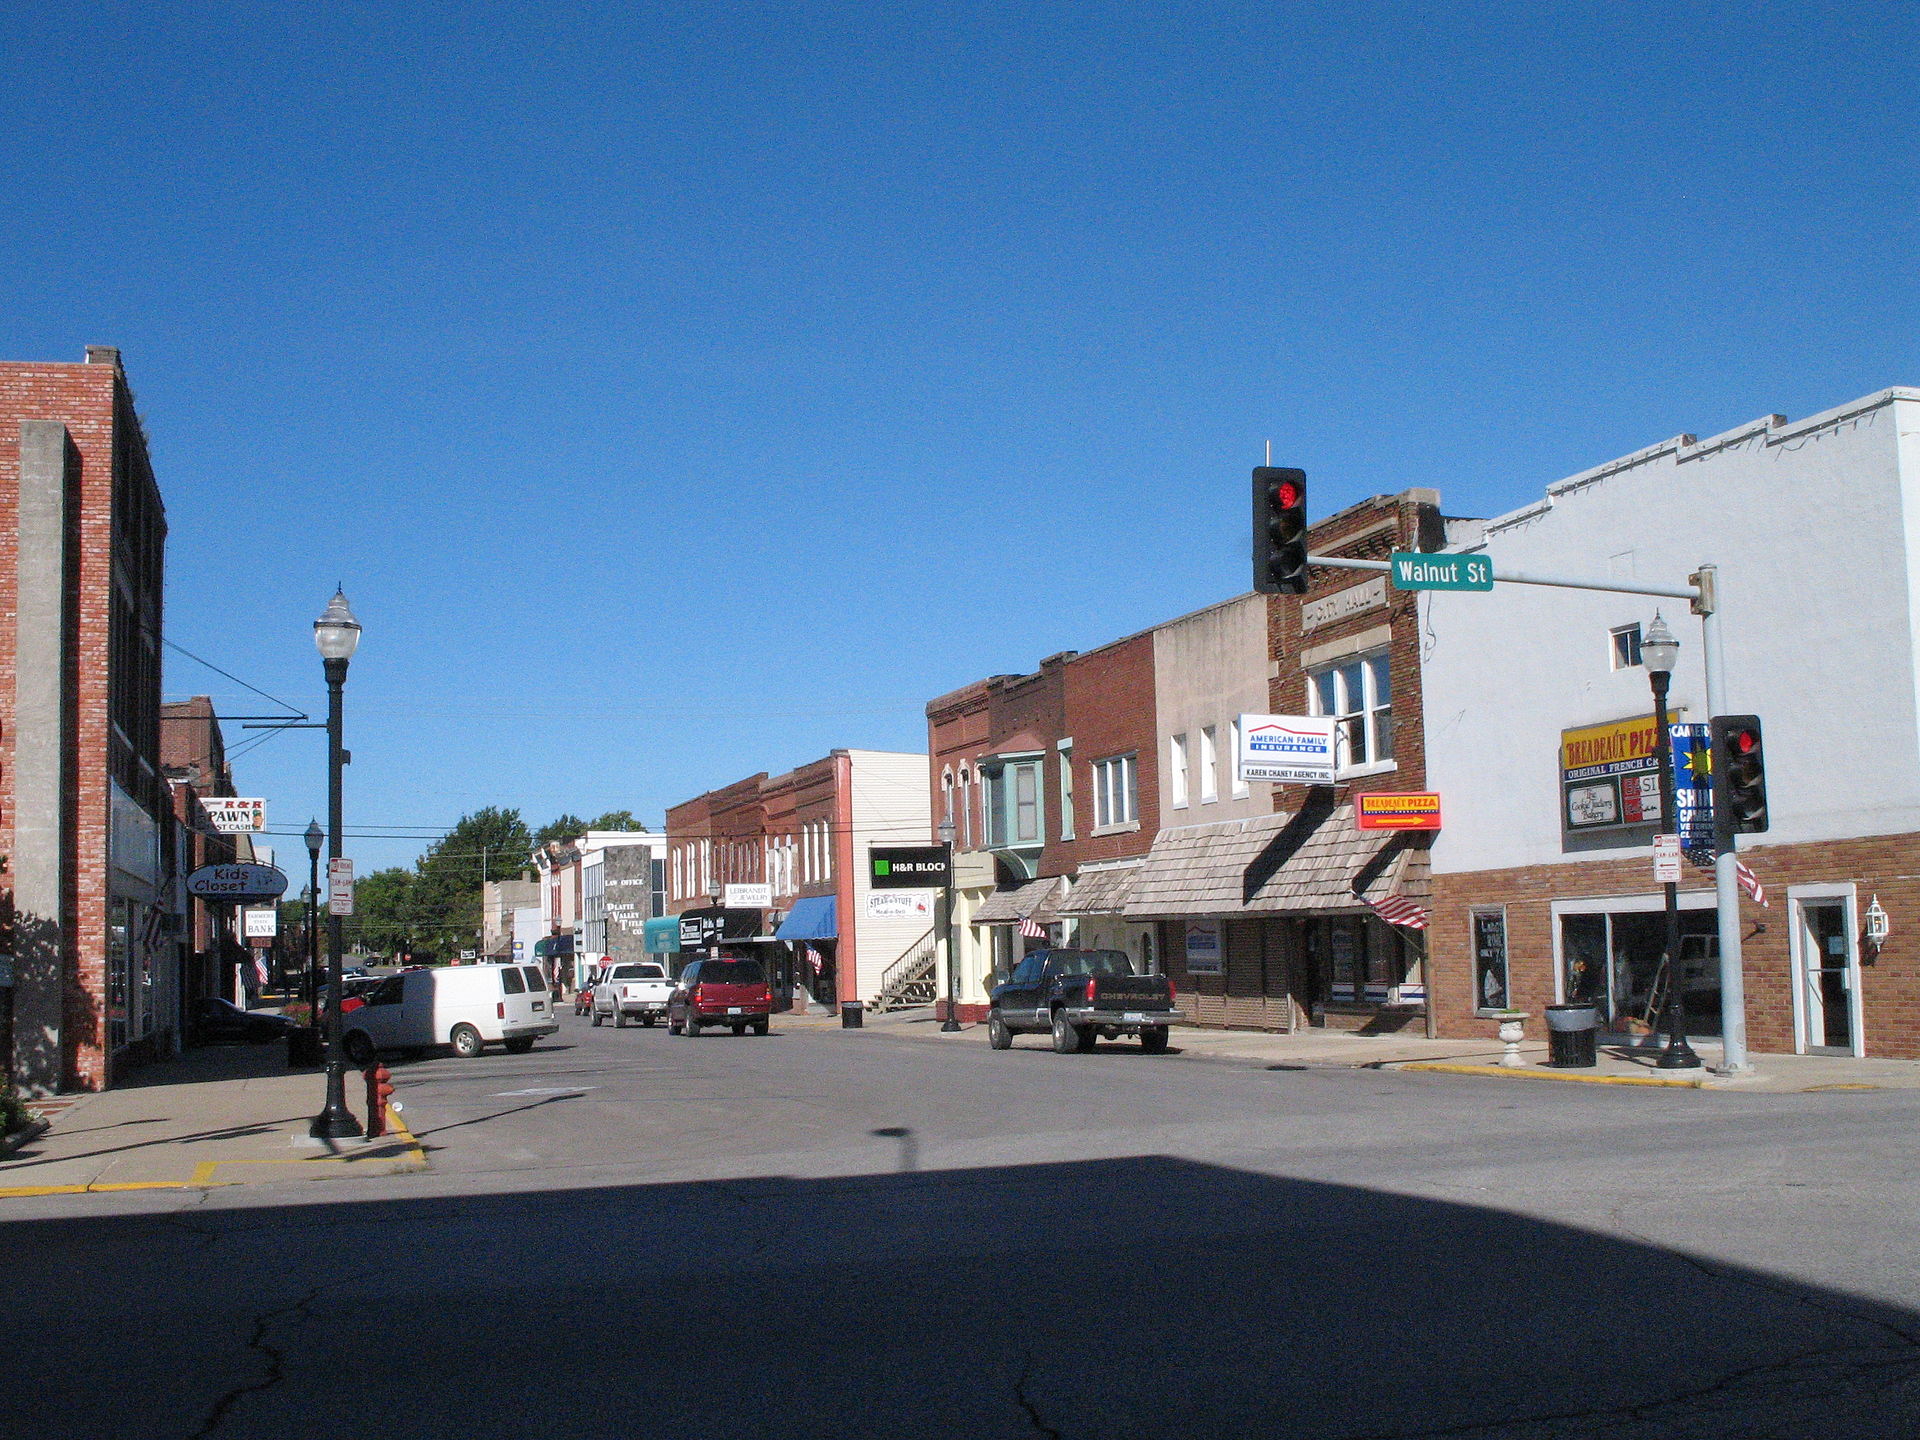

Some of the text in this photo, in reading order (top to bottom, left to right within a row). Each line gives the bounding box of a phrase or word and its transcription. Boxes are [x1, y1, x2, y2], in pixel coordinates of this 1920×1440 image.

[1399, 561, 1487, 583] Walnut St
[1250, 735, 1327, 745] AMERICAN FAMILY
[1629, 728, 1660, 755] PIZ
[1255, 744, 1321, 752] INSURANCE
[1568, 766, 1606, 779] ORIGINAL
[1609, 759, 1643, 773] FRENCH
[1407, 798, 1436, 807] PIZZA
[208, 811, 250, 821] PAWN
[892, 863, 946, 872] H&R BLOCK
[214, 868, 249, 880] Kids
[195, 880, 248, 891] Closet
[607, 903, 634, 911] PLATTE
[612, 911, 639, 922] VALLEY
[248, 925, 274, 933] BANK
[619, 919, 644, 931] TITLE
